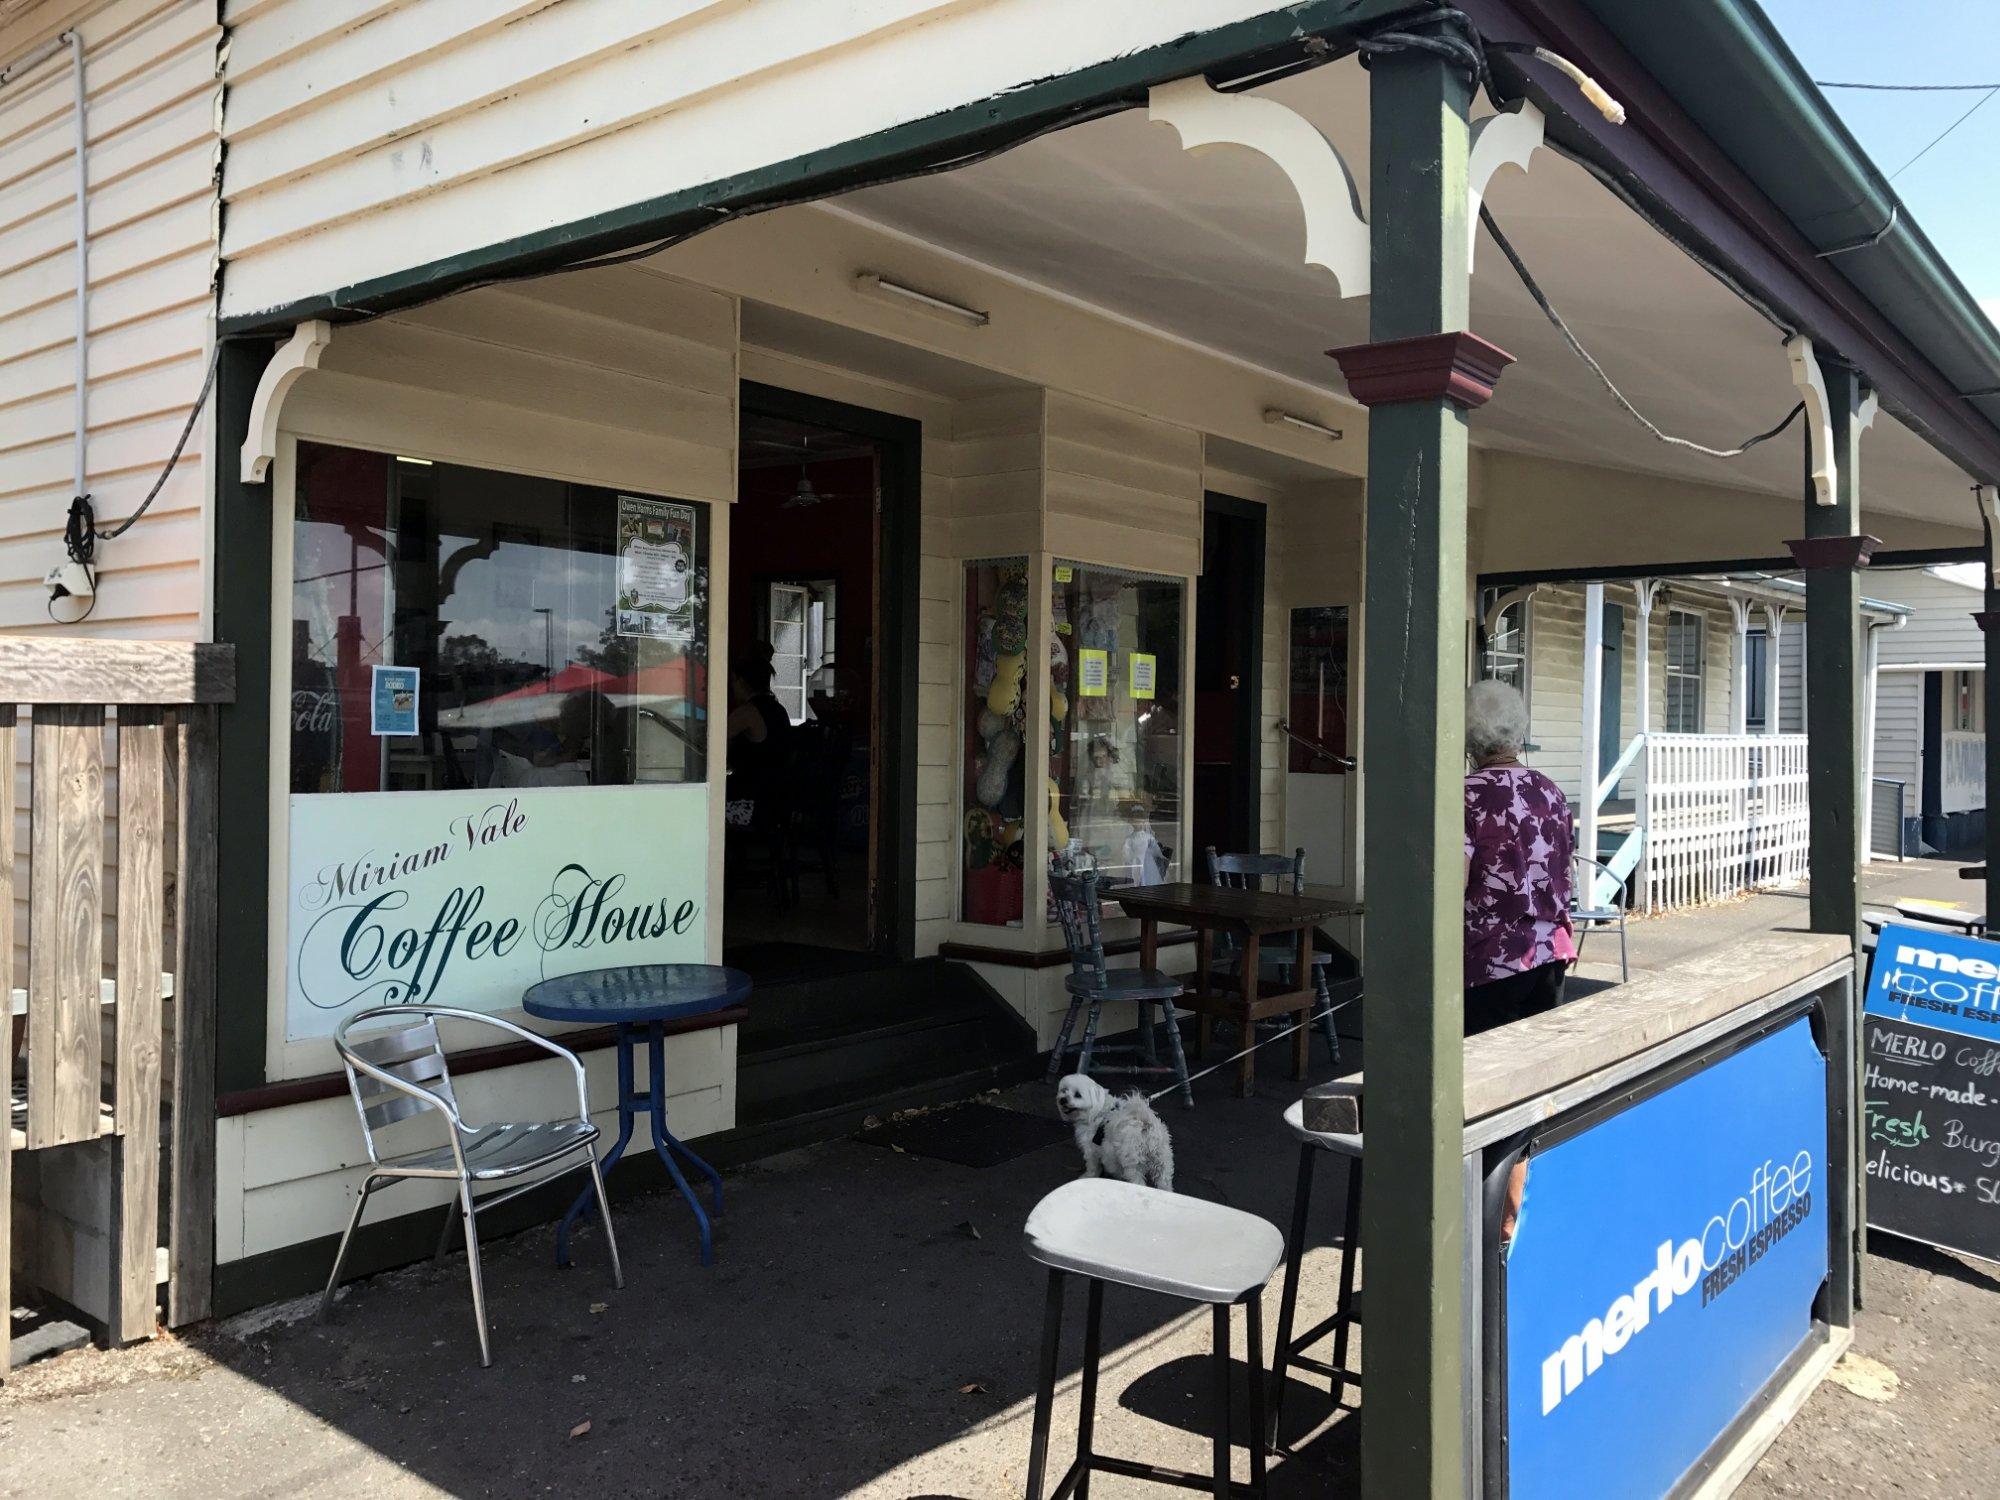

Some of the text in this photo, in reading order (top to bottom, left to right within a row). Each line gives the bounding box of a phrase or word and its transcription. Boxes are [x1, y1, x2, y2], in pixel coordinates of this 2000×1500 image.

[653, 506, 669, 519] Family
[670, 508, 680, 519] Fun
[681, 510, 691, 521] Day
[291, 691, 333, 733] ola
[300, 798, 529, 911] Miriam Vale
[299, 862, 701, 1008] Coffee House
[1896, 945, 2000, 983] me
[1888, 991, 1959, 1016] FRESH
[1870, 1027, 2000, 1076] MERLO Coff
[1701, 1191, 1812, 1309] FRESH ESPRESSO
